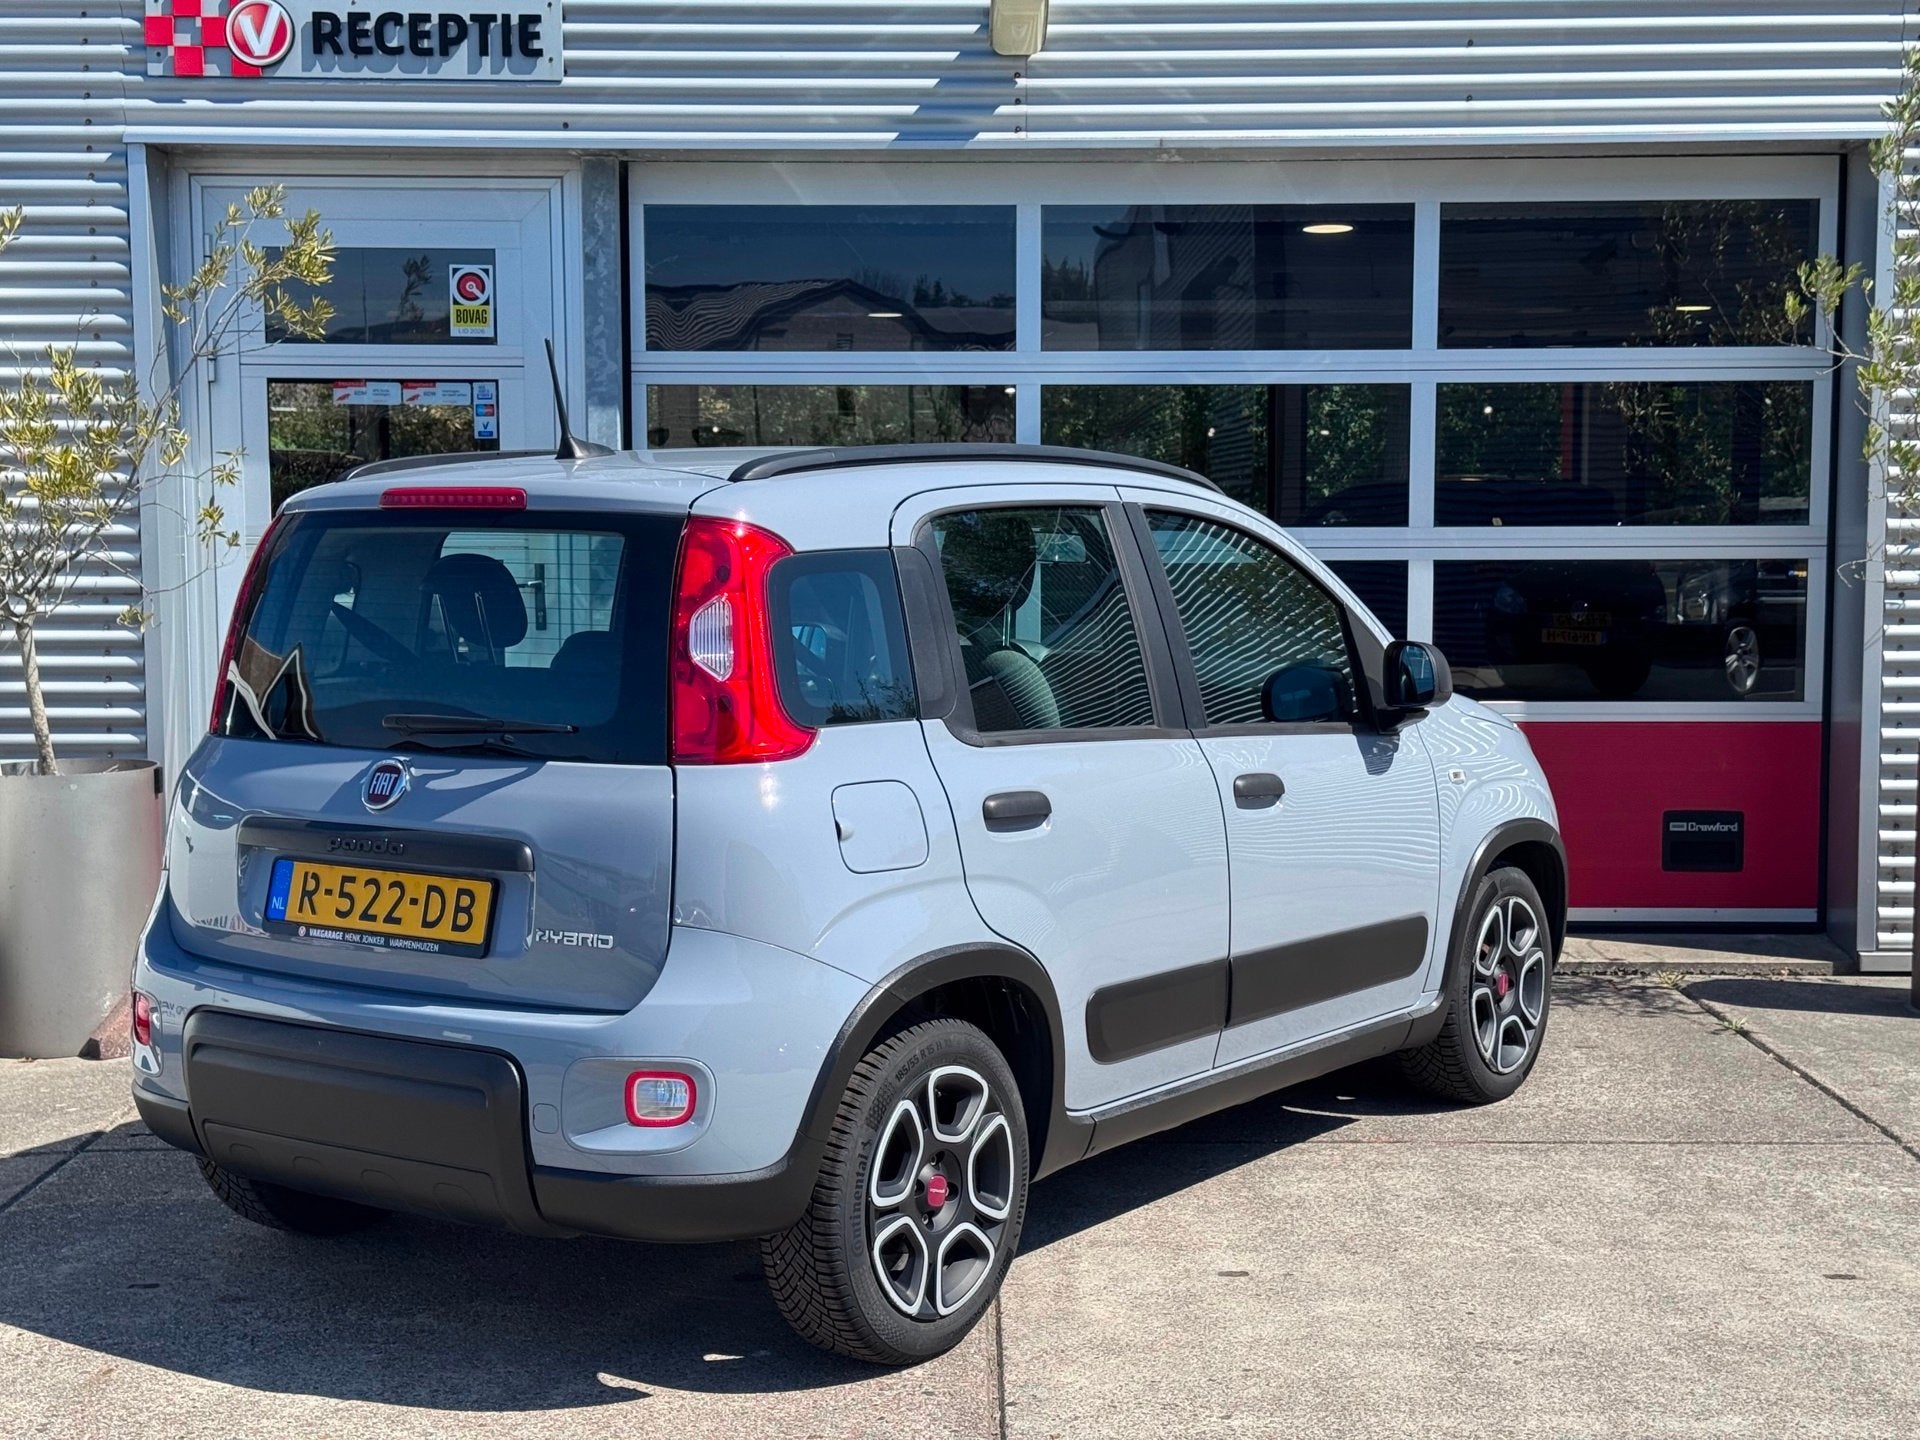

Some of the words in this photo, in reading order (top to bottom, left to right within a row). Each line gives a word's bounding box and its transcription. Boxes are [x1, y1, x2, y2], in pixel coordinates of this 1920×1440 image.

[311, 11, 543, 58] RECEPTIE
[455, 309, 487, 324] BOVAG
[369, 772, 398, 796] FIAT
[1688, 822, 1738, 832] Crawford
[327, 837, 405, 856] panda
[272, 896, 285, 910] NL
[297, 871, 476, 933] R-522-DB
[309, 928, 344, 941] VAKGARAGE
[344, 933, 361, 942] HENK
[362, 936, 385, 946] JONKER
[389, 939, 439, 952] WARMENHUIZEN
[535, 928, 614, 949] HYBRID
[895, 1054, 920, 1082] 185/55
